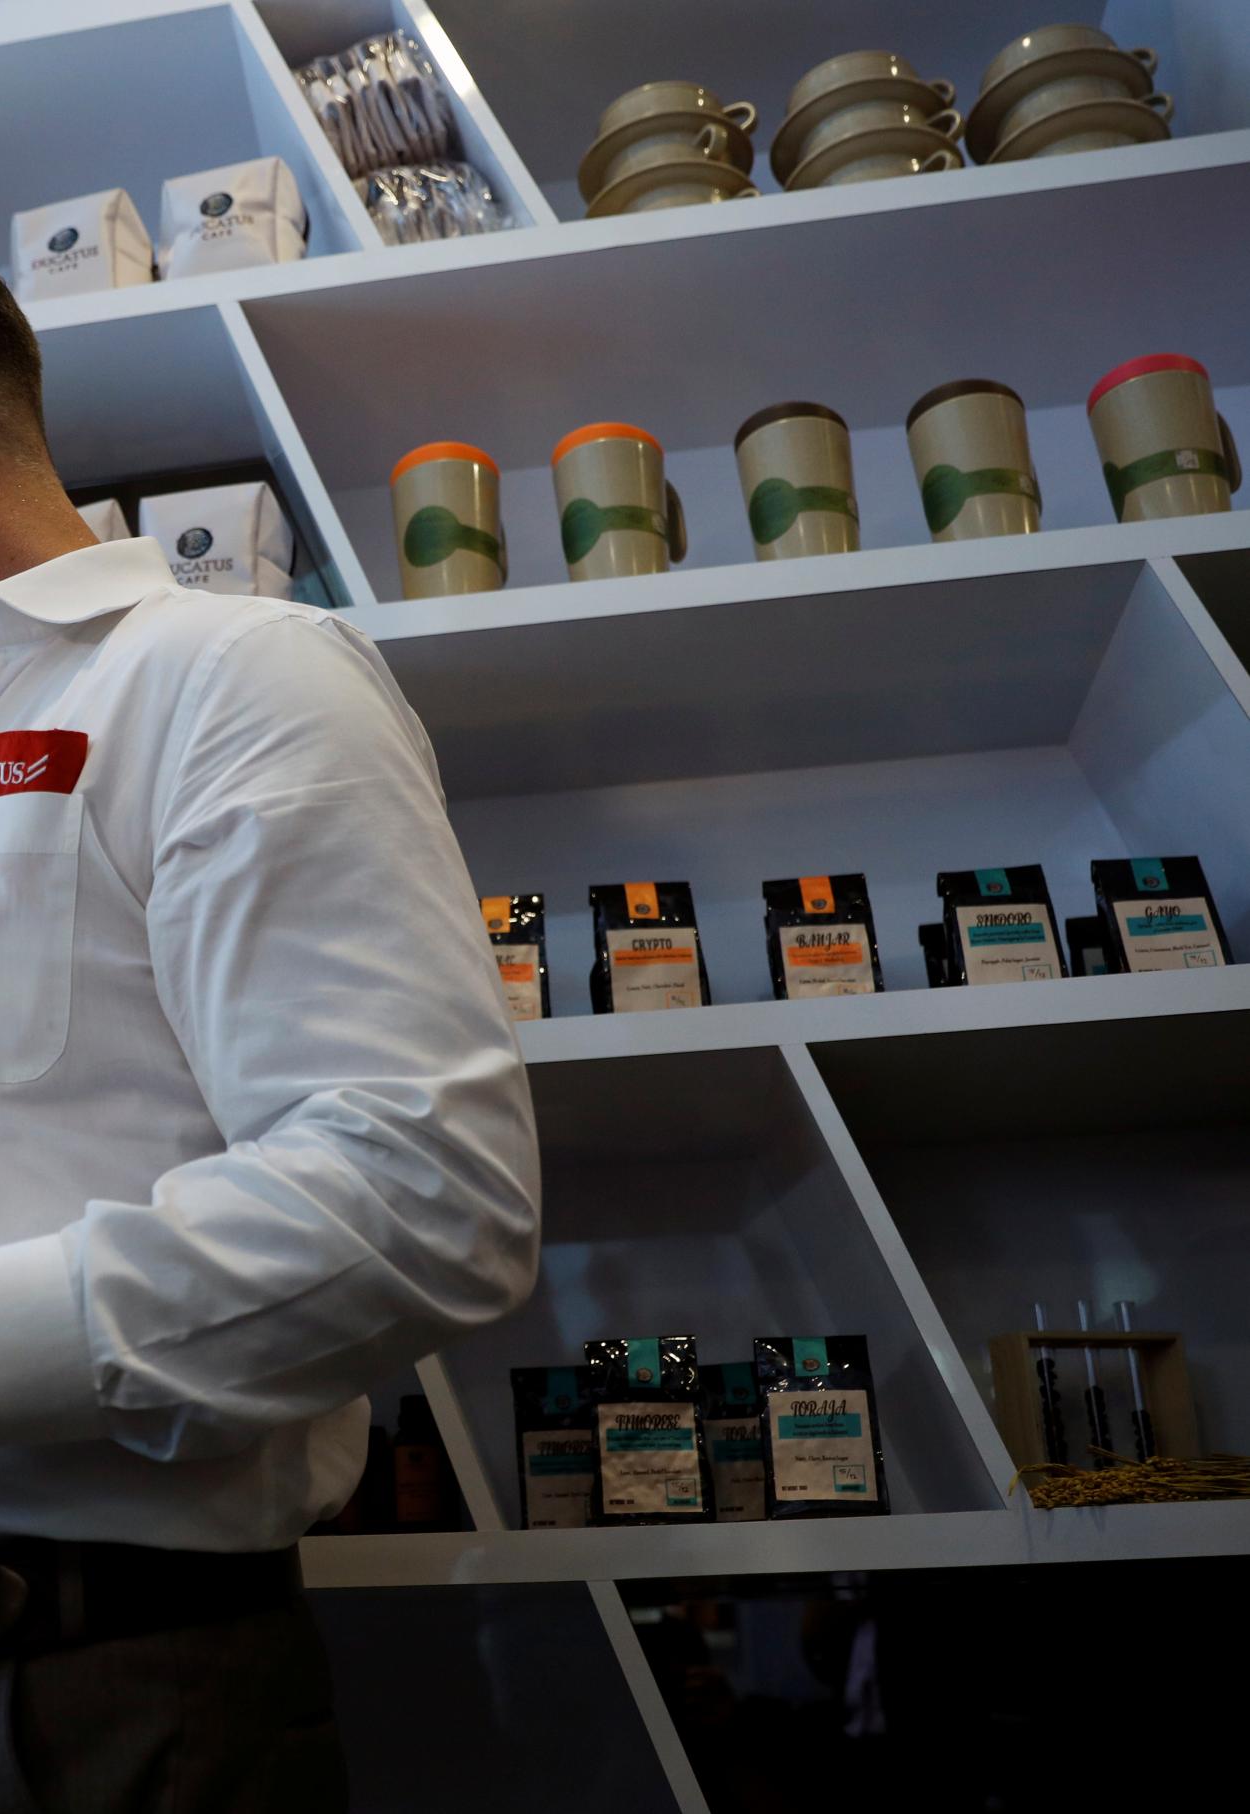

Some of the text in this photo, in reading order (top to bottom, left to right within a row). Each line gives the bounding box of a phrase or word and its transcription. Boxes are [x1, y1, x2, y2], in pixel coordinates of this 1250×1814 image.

[169, 557, 234, 575] UCATUS
[631, 938, 673, 951] CRYPTO
[790, 1399, 847, 1423] TORAJA
